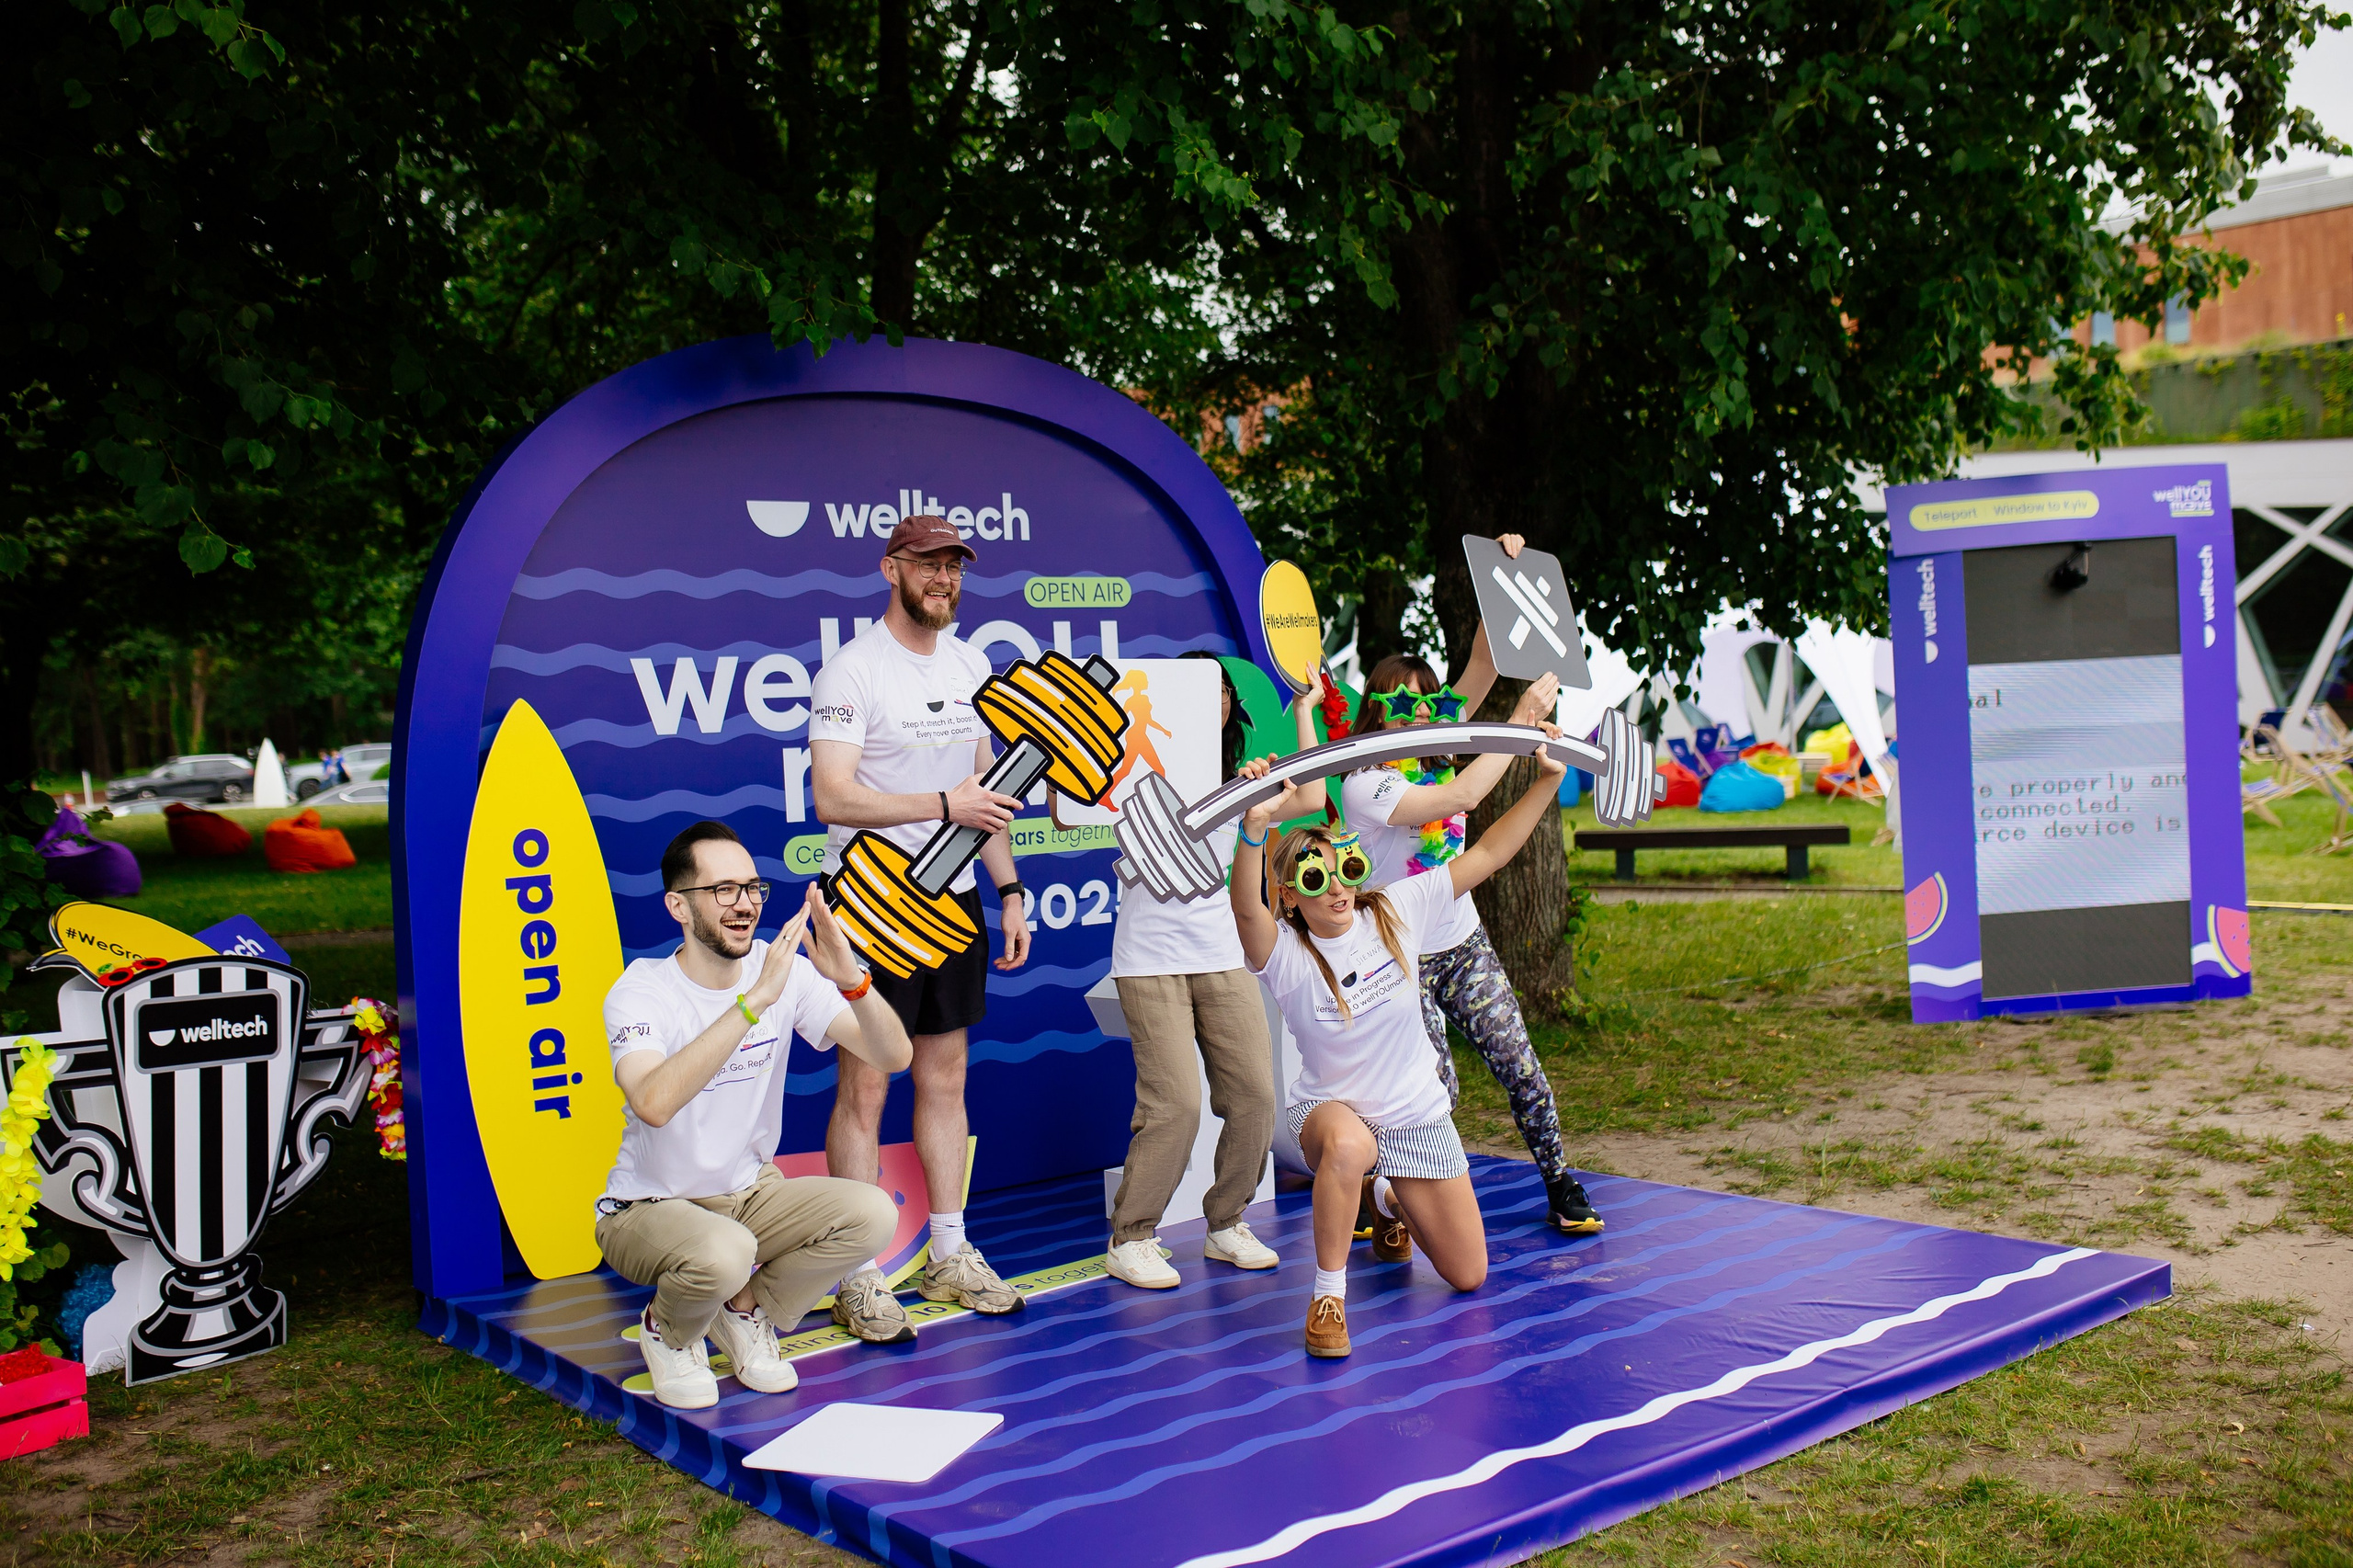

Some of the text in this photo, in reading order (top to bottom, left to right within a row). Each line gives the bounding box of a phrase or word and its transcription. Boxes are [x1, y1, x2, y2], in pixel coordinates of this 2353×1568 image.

[2153, 484, 2211, 503] wellYOU
[1924, 499, 2088, 524] Teleport Window to Kyiv
[1030, 582, 1124, 603] OPEN AIR
[2198, 544, 2215, 622] welltech
[1916, 558, 1938, 638] welltech
[1266, 612, 1318, 630] #WeAreWellmakers
[1969, 688, 2002, 709] al
[814, 705, 855, 718] wellYOU
[902, 721, 919, 729] Step
[916, 731, 932, 739] Every
[950, 726, 972, 735] counts
[2010, 773, 2133, 797] properly
[1980, 794, 2131, 821] connected.
[2043, 820, 2135, 839] device
[2155, 813, 2181, 833] is
[1019, 878, 1121, 932] 202
[506, 828, 583, 1119] open air
[1351, 993, 1360, 1001] in
[1358, 971, 1393, 995] Progress:
[180, 1014, 267, 1043] welltech
[729, 1062, 746, 1072] Go.
[910, 1306, 948, 1316] 10
